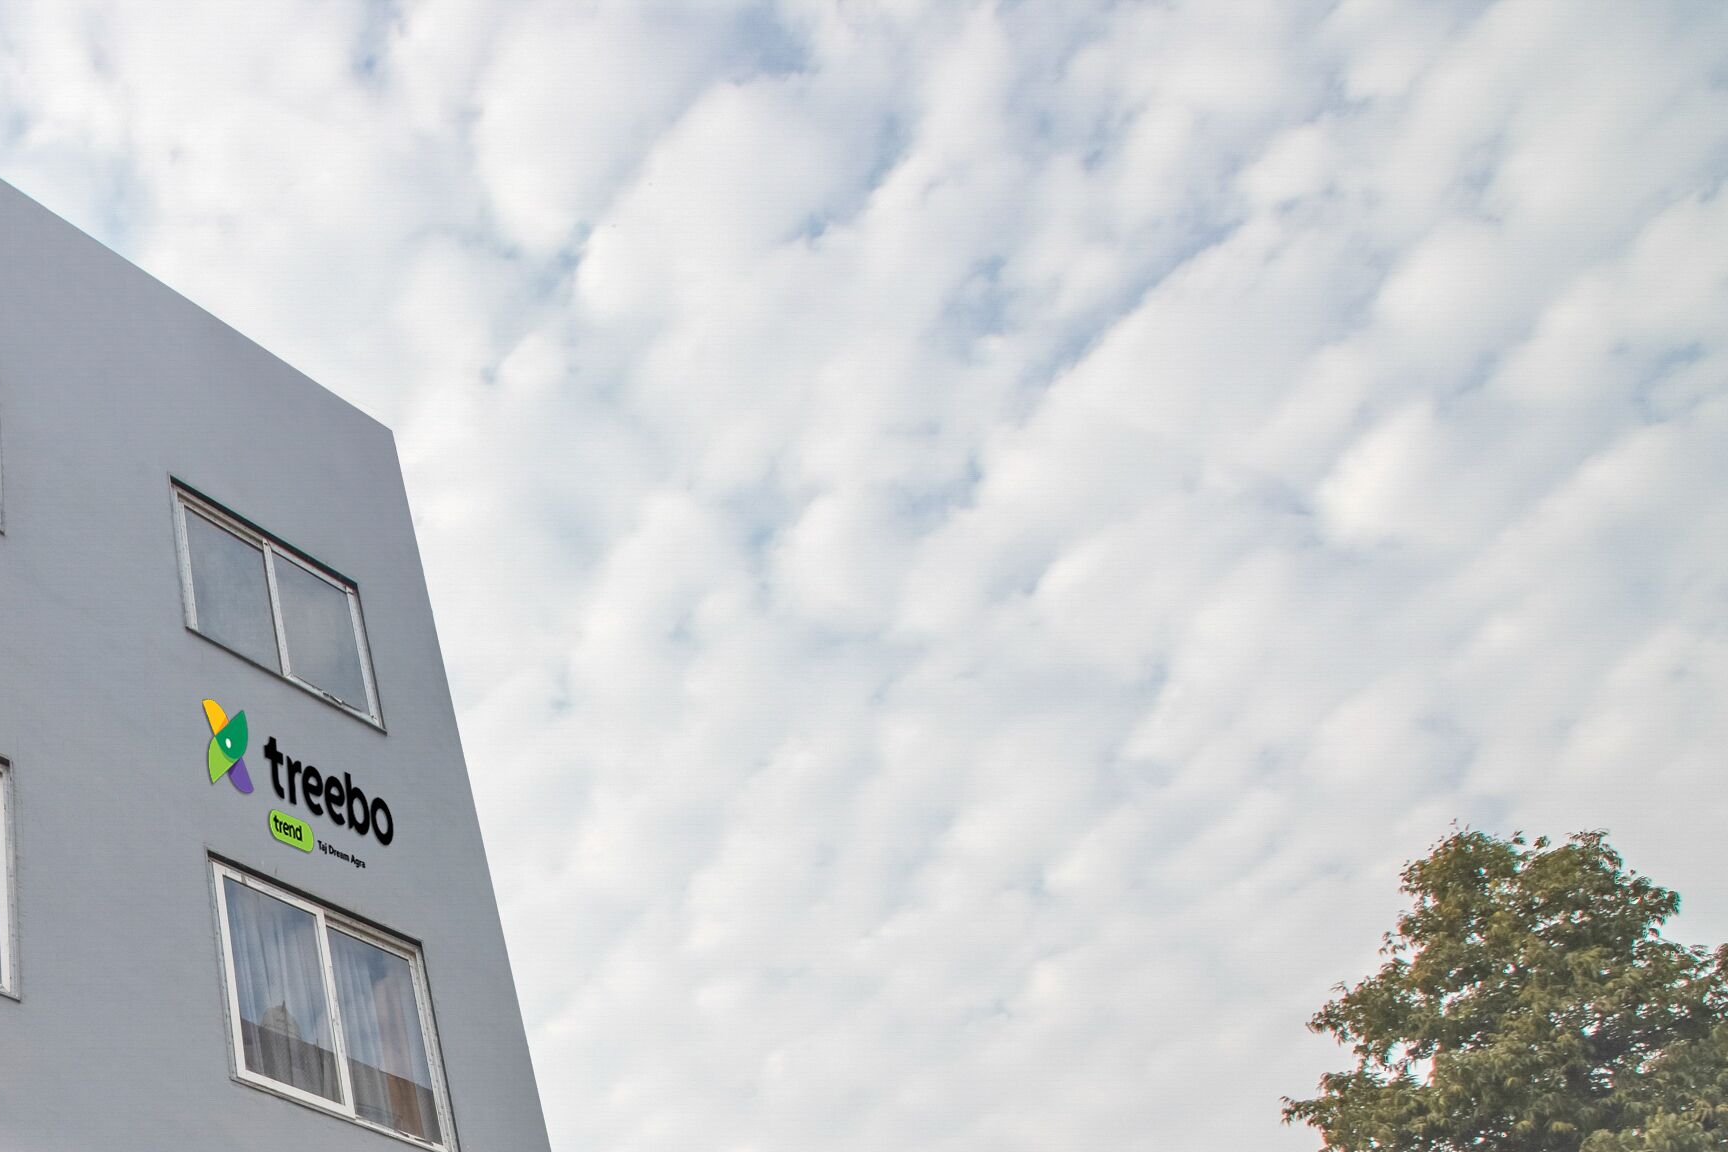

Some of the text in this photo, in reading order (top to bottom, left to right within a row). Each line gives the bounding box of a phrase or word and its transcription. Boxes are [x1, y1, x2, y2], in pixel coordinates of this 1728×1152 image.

[264, 736, 394, 846] treebo
[273, 815, 303, 842] trend
[317, 840, 366, 868] Taj Dream Agra
